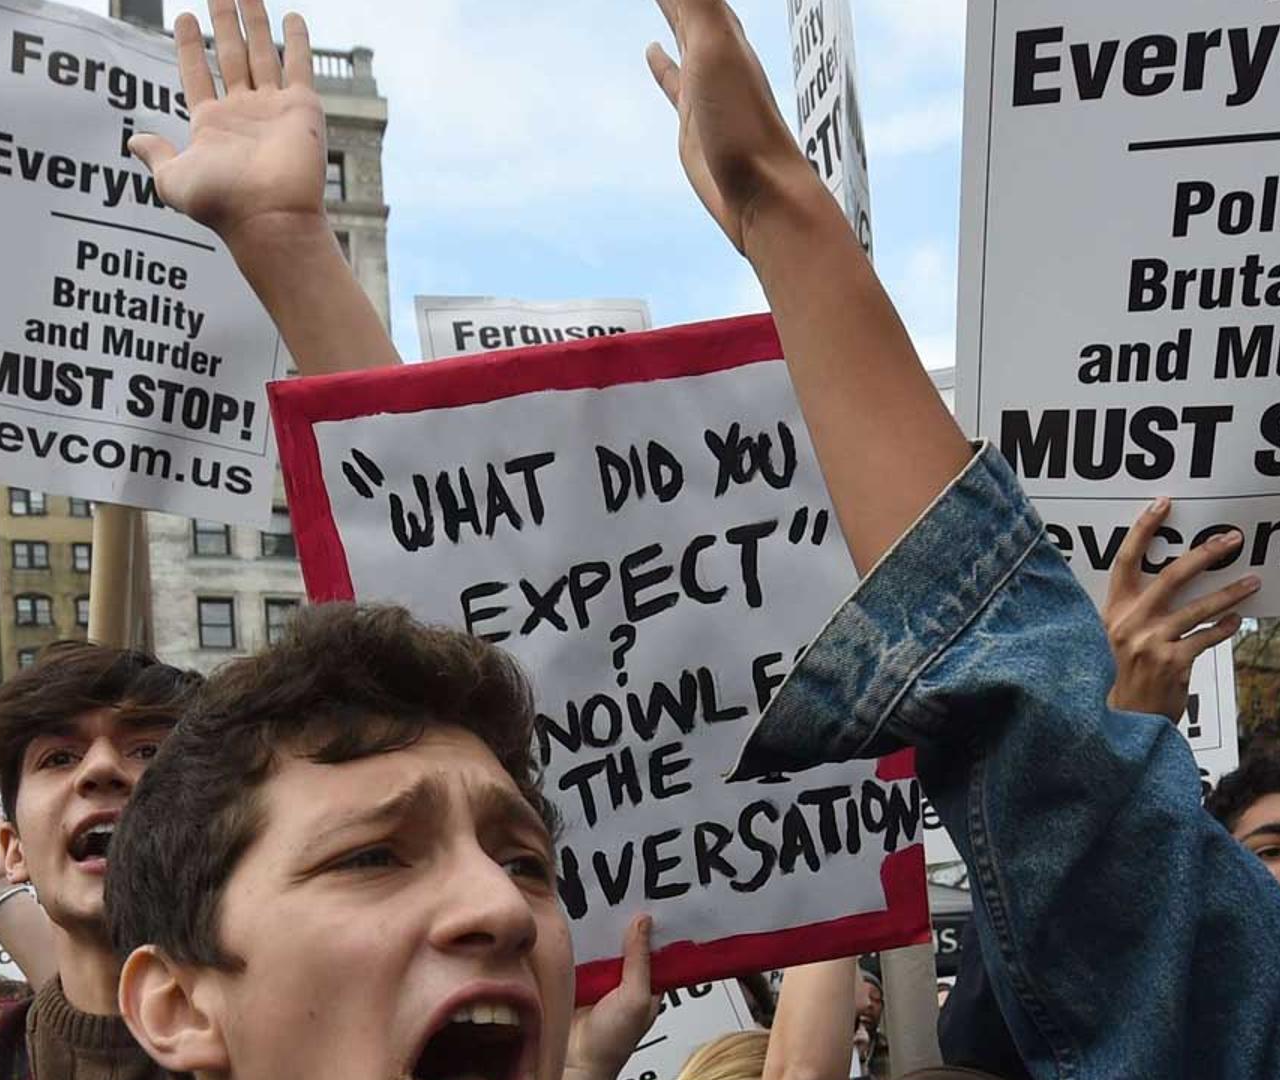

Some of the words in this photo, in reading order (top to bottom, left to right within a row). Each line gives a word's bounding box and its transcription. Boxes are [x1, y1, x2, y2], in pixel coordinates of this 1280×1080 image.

[10, 30, 192, 121] Fergus
[76, 239, 188, 290] Police
[53, 276, 204, 339] Brutality
[24, 318, 89, 351] and
[102, 325, 222, 377] Murder
[1078, 329, 1191, 385] and
[125, 373, 256, 441] STOP!
[999, 404, 1233, 482] MUST
[342, 447, 556, 552] "WHAT
[595, 440, 686, 513] DID
[704, 420, 797, 497] YOU
[460, 507, 829, 642] EXPECT"
[608, 623, 637, 687] ?
[558, 740, 693, 828] THE
